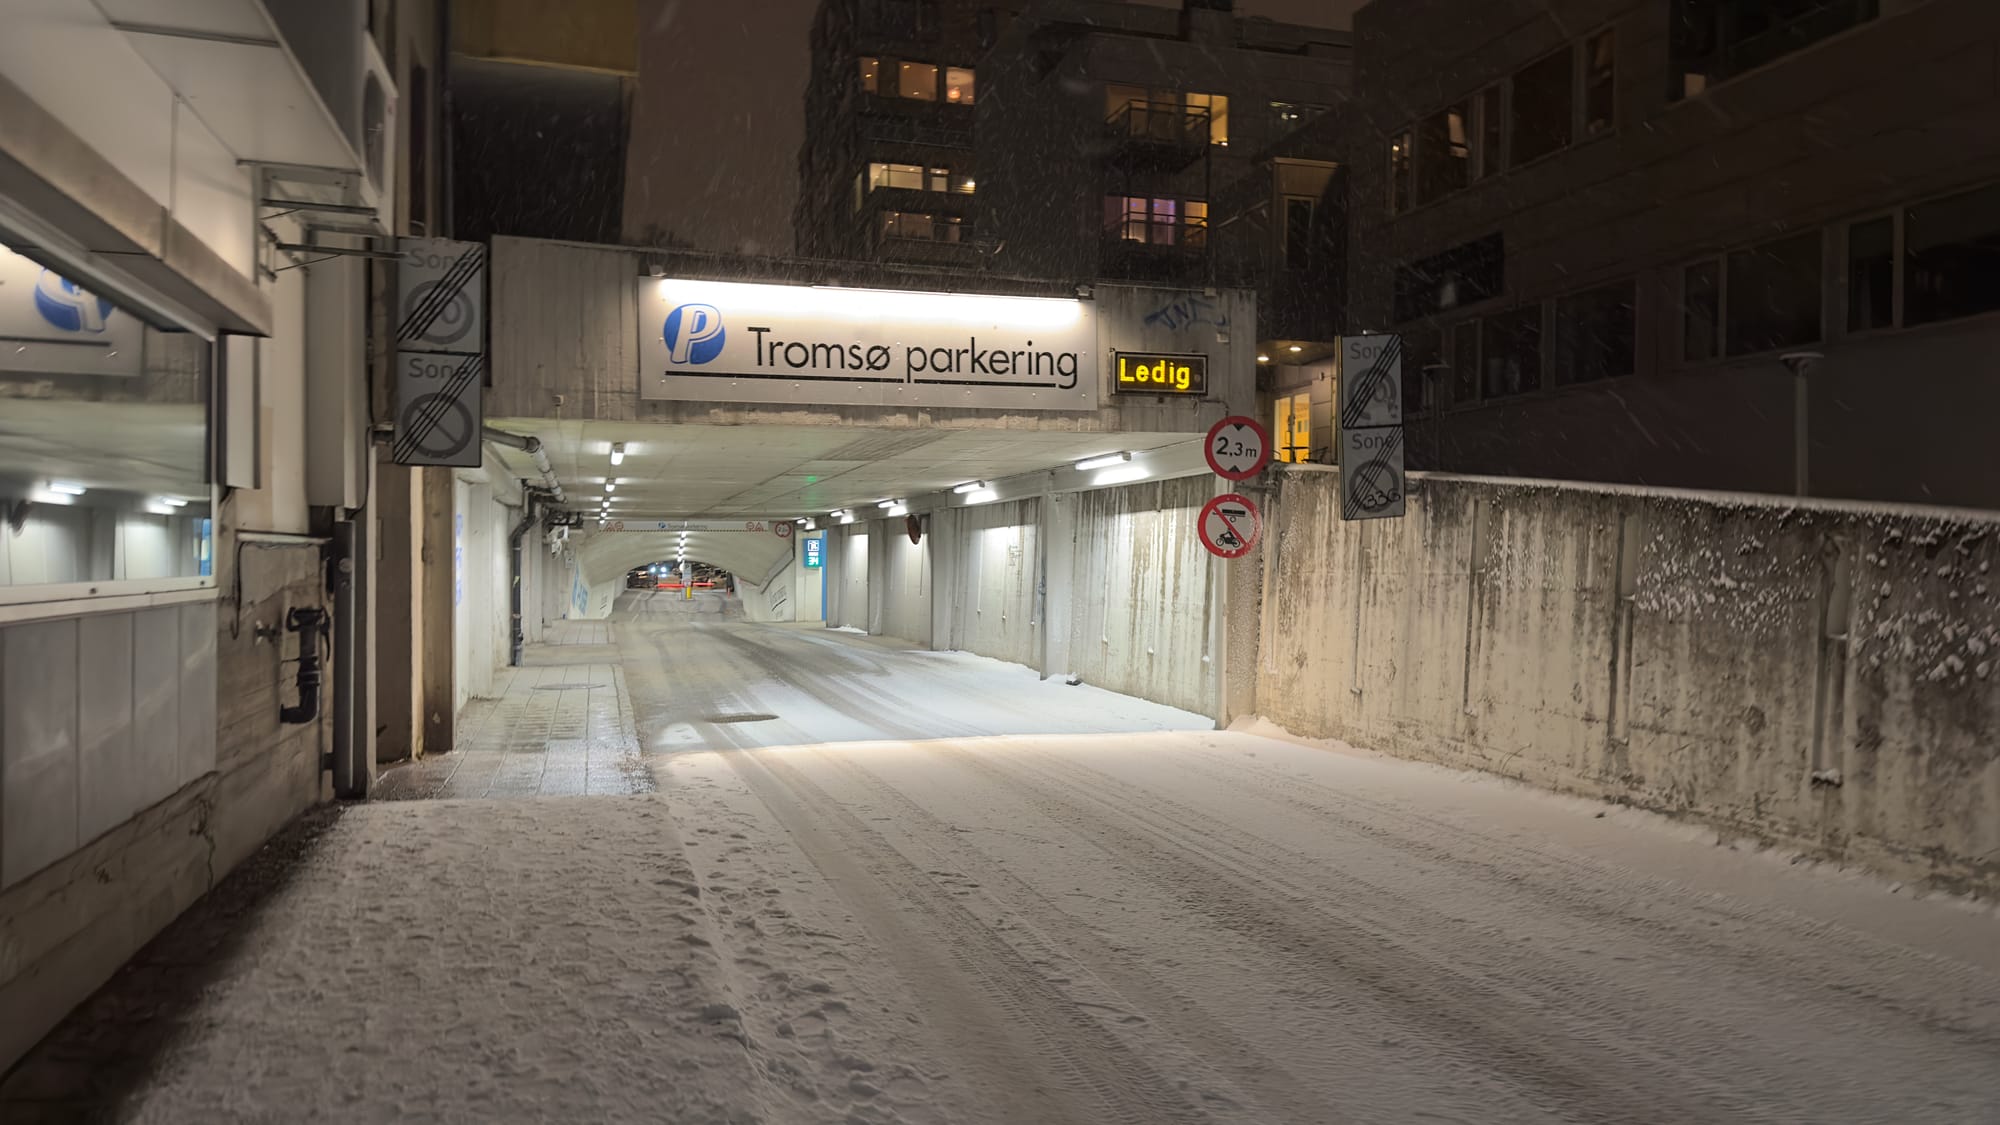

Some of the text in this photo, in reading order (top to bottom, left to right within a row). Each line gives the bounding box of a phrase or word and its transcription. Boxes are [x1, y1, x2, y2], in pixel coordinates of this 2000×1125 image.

[747, 326, 1079, 390] Tromsø parkering
[1119, 358, 1191, 390] Ledig
